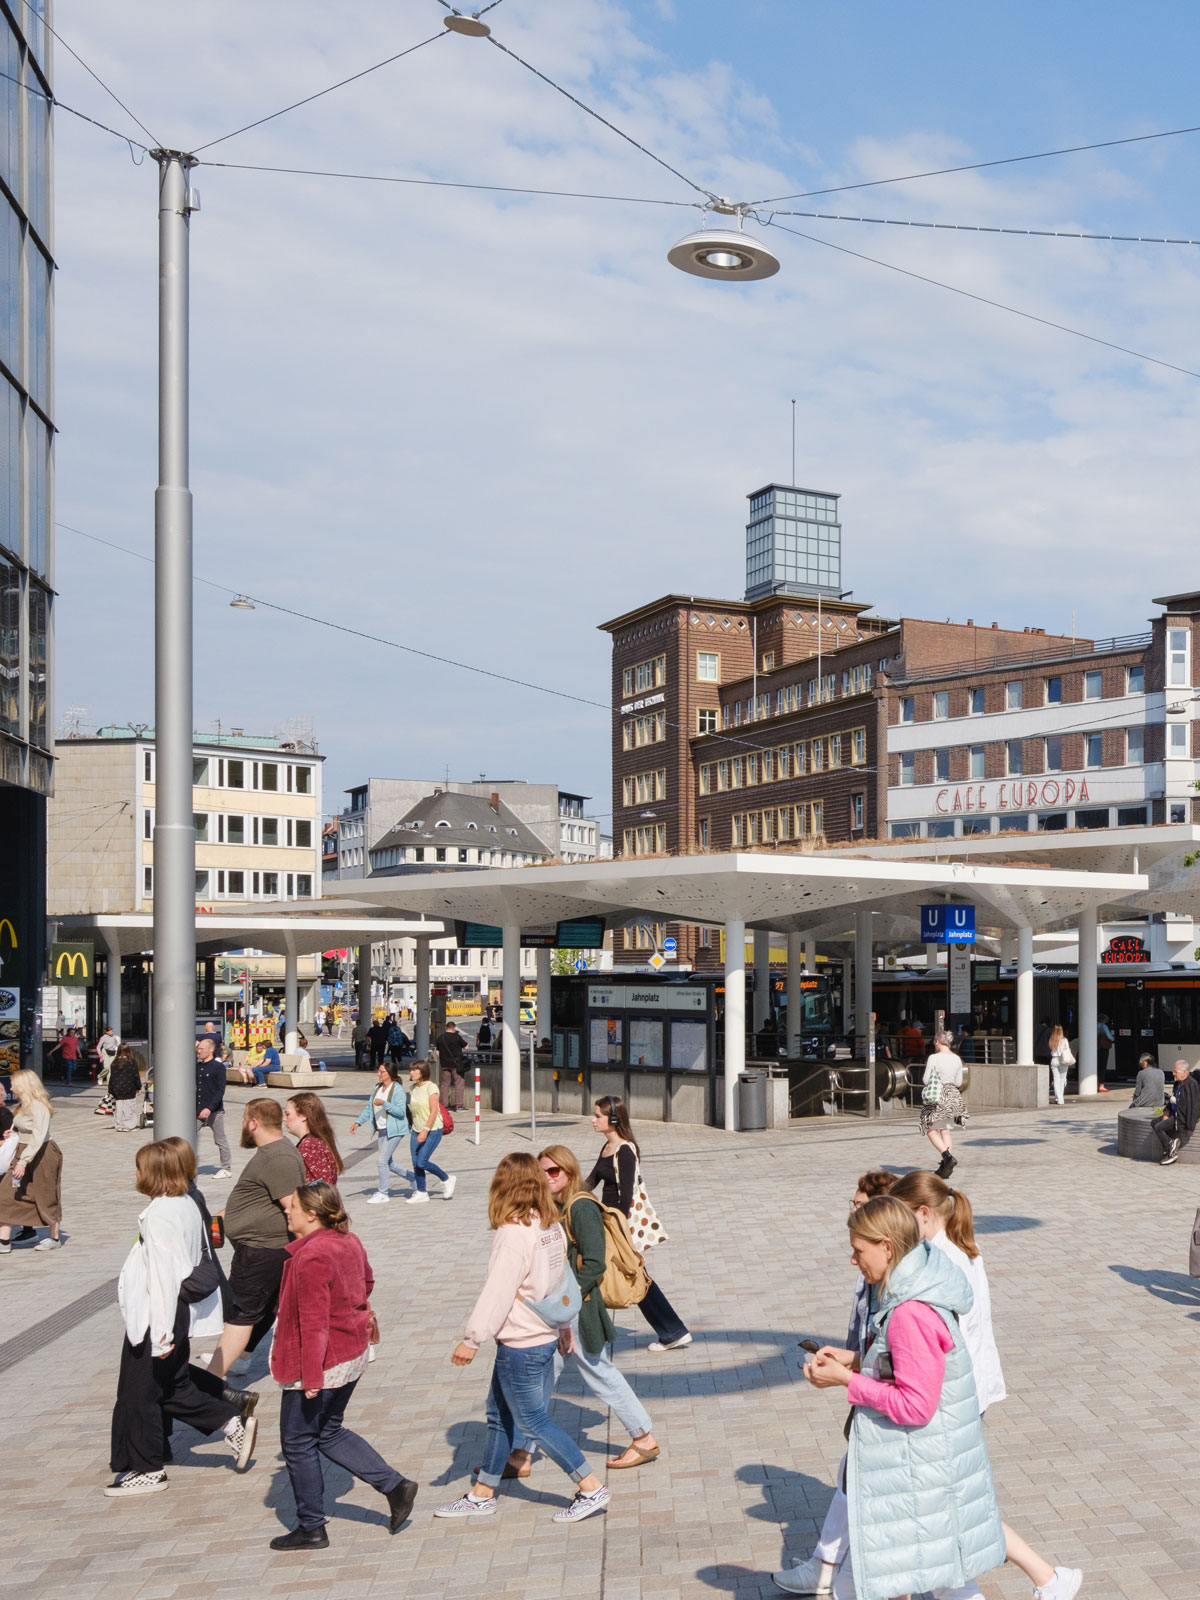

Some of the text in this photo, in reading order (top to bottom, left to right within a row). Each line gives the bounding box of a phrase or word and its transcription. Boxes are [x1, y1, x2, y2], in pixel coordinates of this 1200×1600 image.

[1000, 776, 1090, 808] EUROPA
[928, 909, 939, 926] U
[955, 909, 966, 926] U
[948, 930, 973, 940] Jahnplatz
[631, 992, 660, 1003] Jahnplatz
